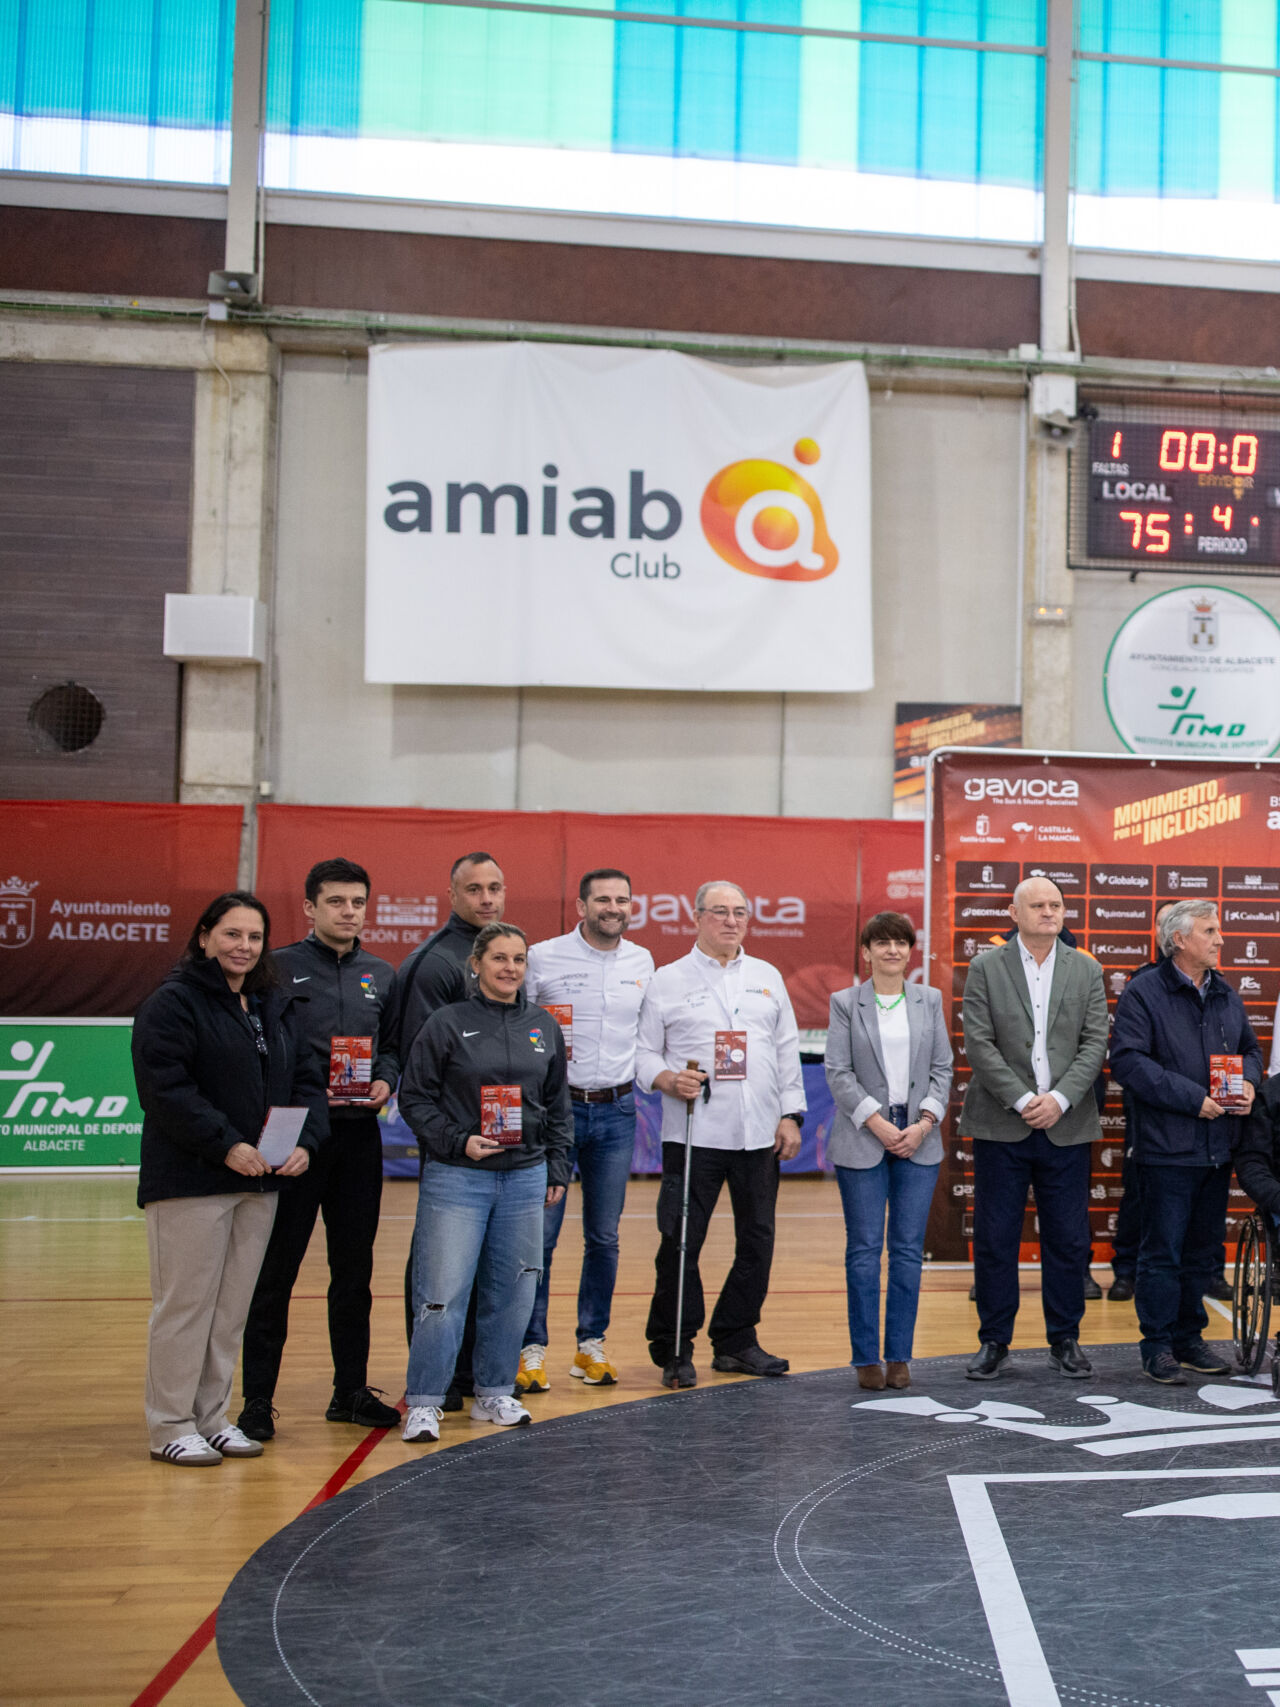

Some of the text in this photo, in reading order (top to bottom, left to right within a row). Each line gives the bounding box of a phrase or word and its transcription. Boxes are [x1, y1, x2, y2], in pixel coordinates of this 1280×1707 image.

[1111, 431, 1122, 458] 1
[1159, 430, 1258, 474] 00:0
[1092, 462, 1129, 476] FALTAS
[1102, 481, 1173, 501] LOCAL
[383, 463, 683, 541] amiab
[1212, 505, 1233, 531] 4
[1119, 511, 1170, 553] 75
[1198, 536, 1248, 554] PERIODO
[610, 552, 682, 580] Club
[1129, 653, 1276, 665] AYUNTAMIENTO DE ALBACETE
[1177, 738, 1217, 749] MUNICIPAL
[964, 778, 1080, 802] gaviota
[992, 797, 1004, 805] The
[1023, 798, 1045, 806] Shutter
[1046, 799, 1079, 807] Specialists
[1113, 779, 1219, 829] MOVIMIENTO
[1142, 792, 1242, 846] INCLUSIÓN
[1038, 834, 1081, 843] LA MANCHA
[1113, 823, 1143, 841] POR LA
[1107, 877, 1149, 888] Globalcaja
[50, 899, 171, 917] Ayuntamiento
[1240, 911, 1275, 921] CaixaBank
[48, 922, 170, 942] ALBACETE
[1107, 946, 1142, 954] CaixaBank
[13, 1124, 82, 1135] MUNICIPAL
[84, 1124, 100, 1135] DE
[102, 1123, 143, 1135] DEPOR
[23, 1139, 86, 1151] ALBACETE
